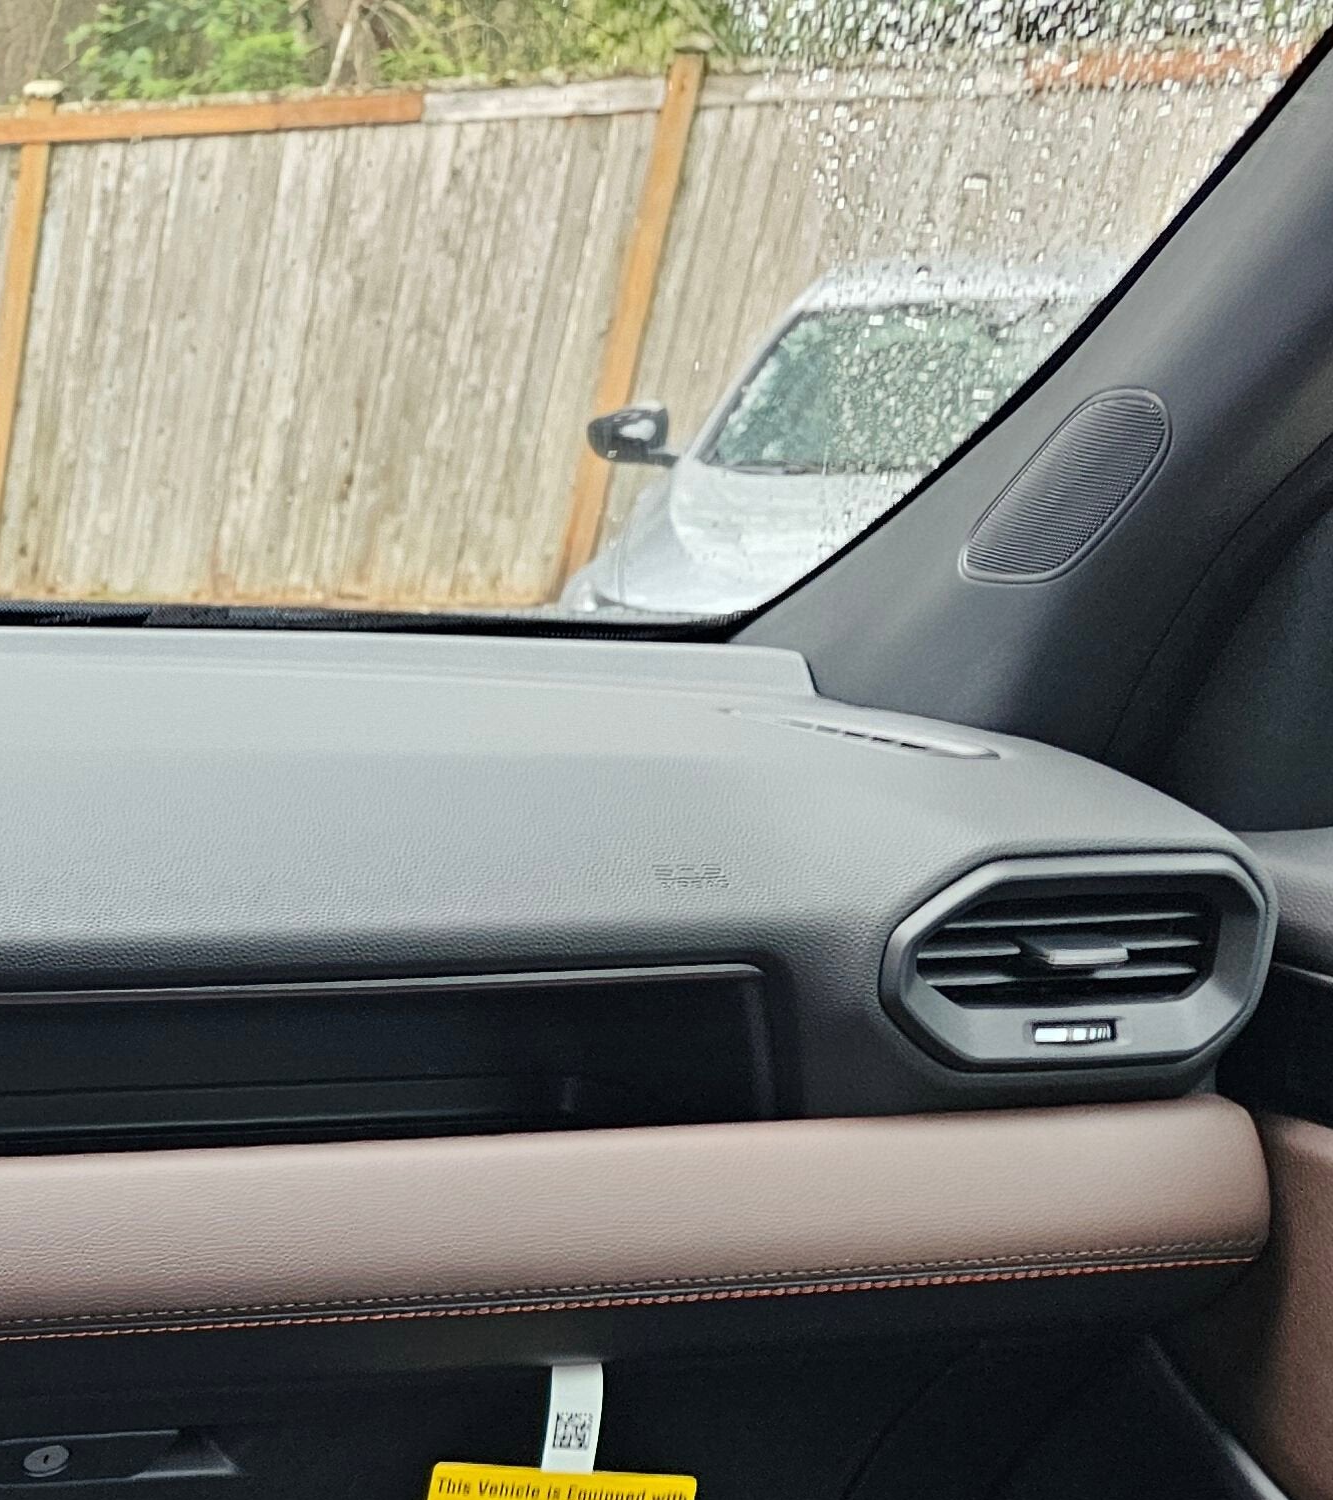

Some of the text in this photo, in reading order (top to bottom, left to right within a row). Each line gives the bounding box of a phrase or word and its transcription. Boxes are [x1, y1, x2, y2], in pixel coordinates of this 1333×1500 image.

[437, 1477, 470, 1496] This
[478, 1479, 541, 1498] Vehicle
[547, 1485, 561, 1500] is
